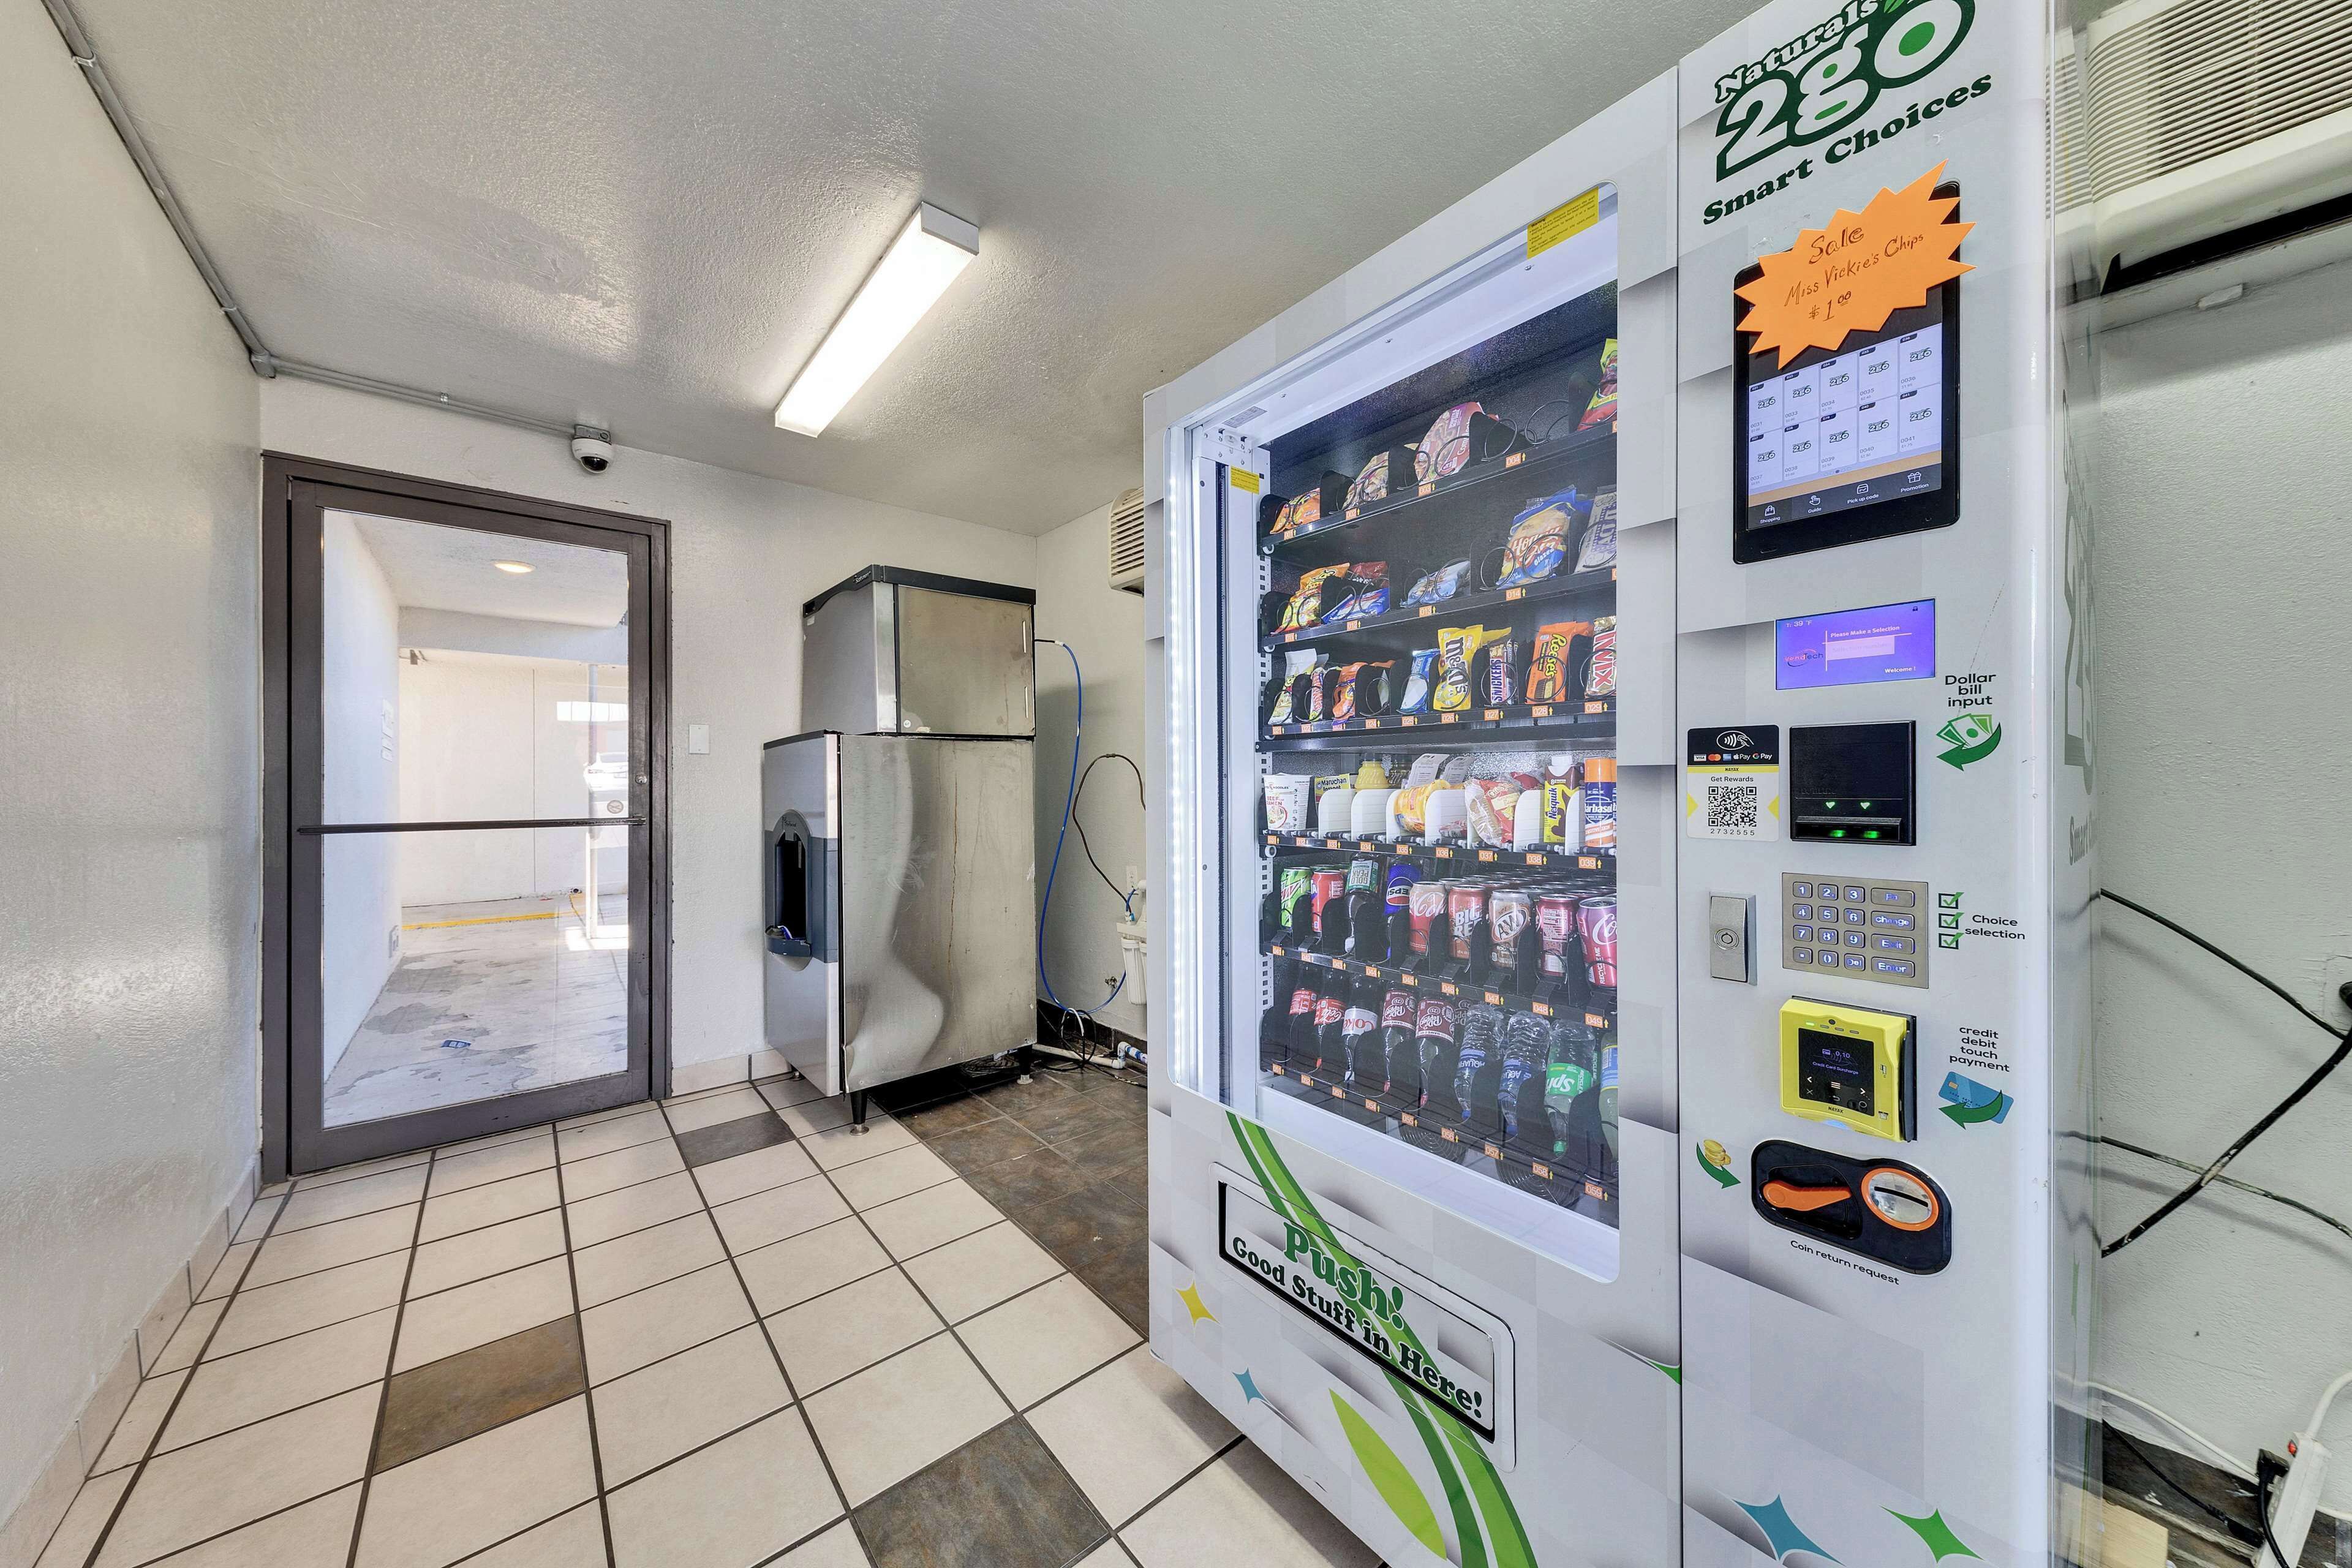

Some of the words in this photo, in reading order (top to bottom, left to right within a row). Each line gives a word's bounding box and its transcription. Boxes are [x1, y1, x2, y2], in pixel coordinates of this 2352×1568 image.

[1715, 0, 1878, 104] Naturals
[1703, 159, 1813, 225] Smart
[1825, 74, 1992, 164] Choices
[1809, 226, 1864, 265] Sale
[1784, 281, 1819, 307] Miss
[1825, 253, 1880, 288] Vickie's
[1884, 233, 1924, 258] Chips
[1901, 483, 1929, 492] Promotion
[1760, 516, 1781, 524] Shopping
[1507, 590, 1520, 599] 014
[1420, 607, 1431, 616] 013
[1544, 633, 1567, 677] Reese's
[1490, 658, 1502, 704] SNICKERS
[1945, 673, 1997, 685] Dollar
[1959, 684, 1982, 696] bill
[1948, 695, 1992, 709] input
[1533, 707, 1548, 715] 028
[1586, 703, 1601, 712] 029
[1321, 777, 1347, 786] Maruchan
[1548, 787, 1560, 820] Nesquik
[1579, 859, 1594, 868] 039
[1387, 888, 1409, 897] EPSI
[1823, 888, 1831, 897] 2
[1850, 891, 1858, 899] 3
[1798, 908, 1806, 917] 4
[1823, 910, 1831, 919] 5
[1849, 913, 1857, 922] 6
[1972, 914, 2018, 927] Choice
[1453, 921, 1474, 938] RE
[1798, 929, 1805, 938] 7
[1965, 927, 2026, 941] selection
[1823, 932, 1831, 941] 8
[1850, 935, 1858, 944] 9
[1594, 947, 1600, 957] ME
[1823, 954, 1831, 963] 0
[1878, 962, 1907, 973] Enter
[1486, 994, 1499, 1003] 047
[1385, 1005, 1404, 1016] Pepper
[1534, 1004, 1548, 1014] 048
[1419, 1015, 1441, 1026] Pepper
[1586, 1016, 1602, 1026] 049
[1959, 1027, 1999, 1040] credit
[1961, 1036, 1997, 1050] debit
[1959, 1046, 1998, 1060] touch
[1949, 1054, 2010, 1073] payment
[1504, 1070, 1522, 1079] AQUA
[1837, 1066, 1859, 1075] Surcharge
[1486, 1147, 1498, 1156] 057
[1533, 1165, 1547, 1175] 058
[1586, 1186, 1601, 1196] 059
[1790, 1239, 1814, 1254] Coin
[1815, 1249, 1851, 1268] return
[1853, 1263, 1899, 1286] request
[1283, 1221, 1404, 1330] Push!
[1232, 1236, 1286, 1286] Good
[1292, 1275, 1356, 1333] Stuff
[1362, 1318, 1392, 1359] in
[1398, 1342, 1483, 1419] Here!
